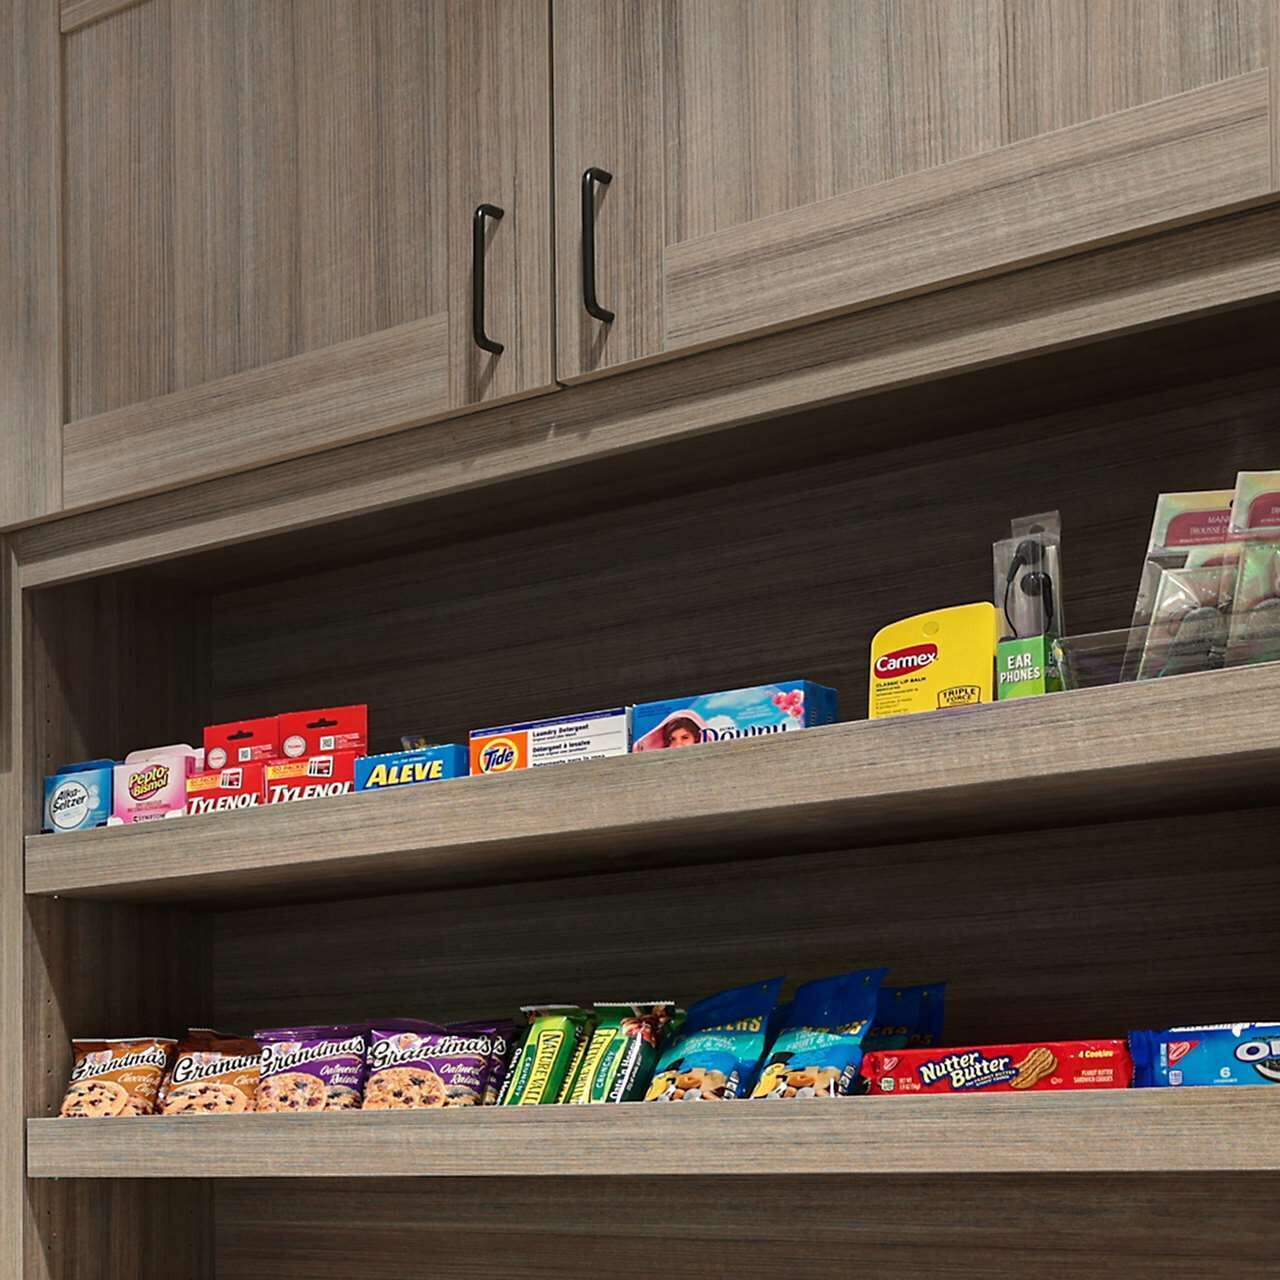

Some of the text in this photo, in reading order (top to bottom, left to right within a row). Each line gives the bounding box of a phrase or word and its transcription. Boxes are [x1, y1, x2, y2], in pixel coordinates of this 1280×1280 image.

[876, 651, 936, 672] Carmex
[1007, 652, 1032, 669] EAR
[1000, 666, 1041, 684] PHONES
[943, 688, 976, 698] TRIPLE
[532, 729, 558, 738] Laundry
[559, 724, 589, 735] Detergent
[484, 746, 515, 771] Tide
[129, 767, 169, 787] Pepto-
[365, 759, 444, 788] ALEVE
[57, 788, 81, 800] Alka-
[133, 774, 168, 797] Bismol
[270, 781, 354, 804] TYLENOL
[53, 795, 87, 813] Seltzer
[189, 792, 261, 816] TYLENOL
[261, 1036, 364, 1077] Grandma's
[371, 1036, 491, 1069] Grandma's
[537, 1033, 562, 1078] NATURE
[1084, 1050, 1114, 1058] Cookies
[71, 1049, 166, 1081] Grandma's
[173, 1054, 261, 1085] Grandm
[320, 1064, 360, 1075] Oatmeal
[595, 1050, 617, 1088] CRUNCHY
[919, 1052, 981, 1084] Nutter
[950, 1056, 1010, 1088] Butter
[1219, 1066, 1231, 1078] 6
[329, 1074, 359, 1085] Raisin
[450, 1074, 481, 1085] Raisin
